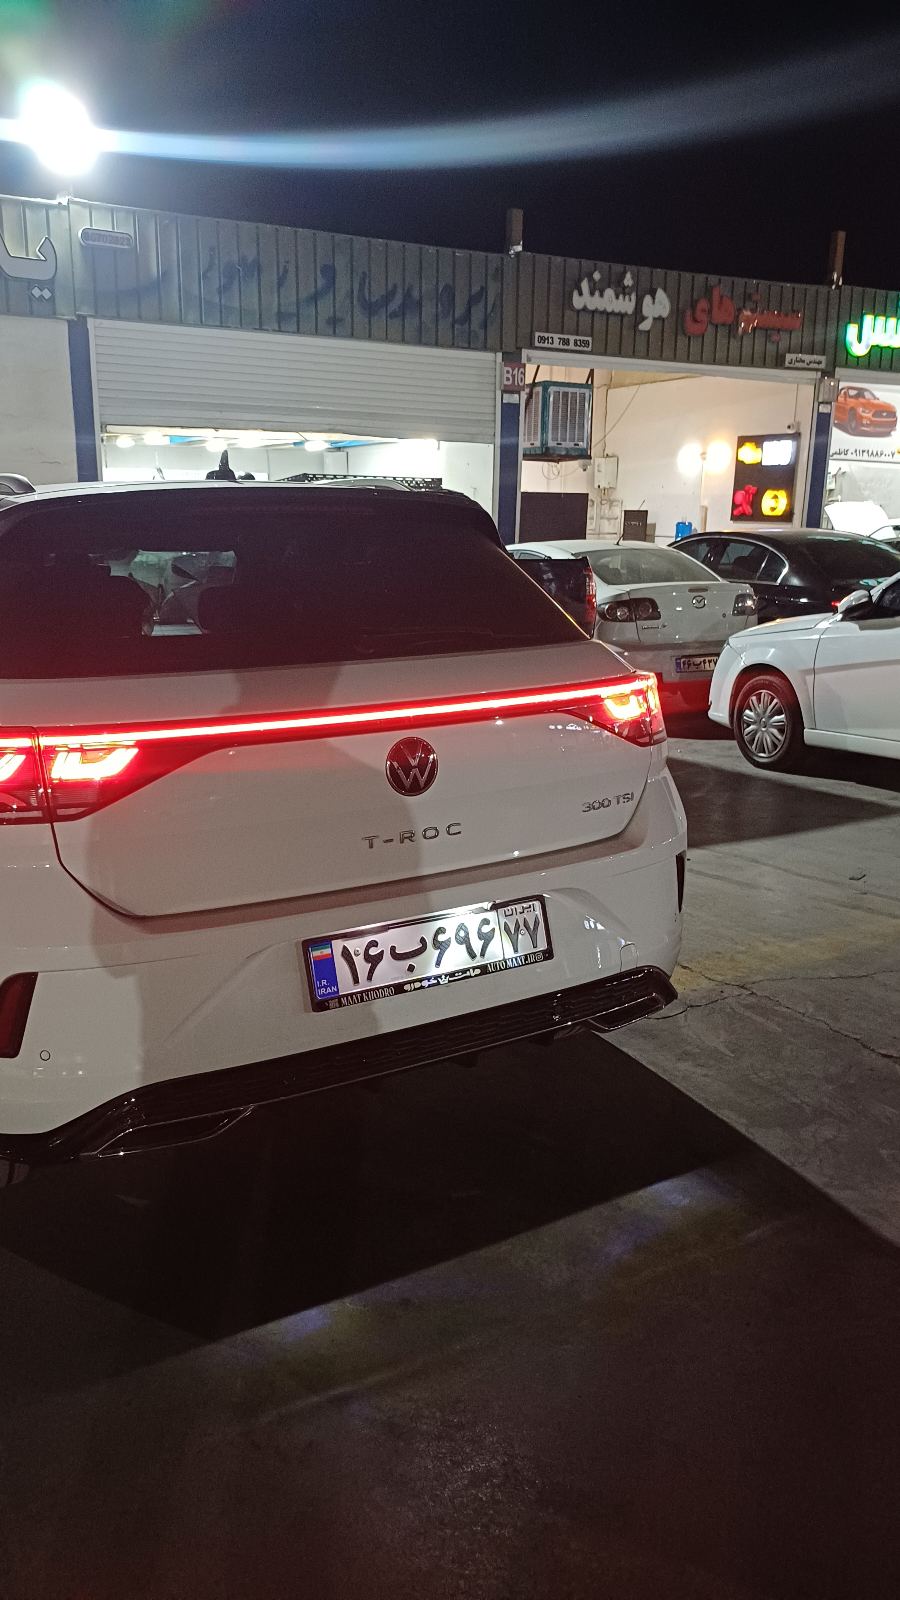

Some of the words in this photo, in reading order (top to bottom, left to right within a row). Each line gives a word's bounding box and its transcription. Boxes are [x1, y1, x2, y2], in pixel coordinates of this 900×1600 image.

[572, 270, 671, 331] هوشمند
[537, 335, 554, 345] 0913
[557, 337, 571, 347] 788
[573, 338, 590, 348] 8359
[806, 358, 823, 366] مهندس
[503, 367, 525, 386] B16
[582, 797, 611, 813] 300
[613, 792, 635, 808] TSI
[362, 822, 463, 849] T-ROC
[503, 902, 536, 917] ایران
[487, 960, 507, 973] AUTO
[316, 979, 330, 988] I.R.
[318, 985, 338, 996] IRAN
[340, 994, 362, 1007] MAAT
[363, 986, 395, 1002] KHODRO
